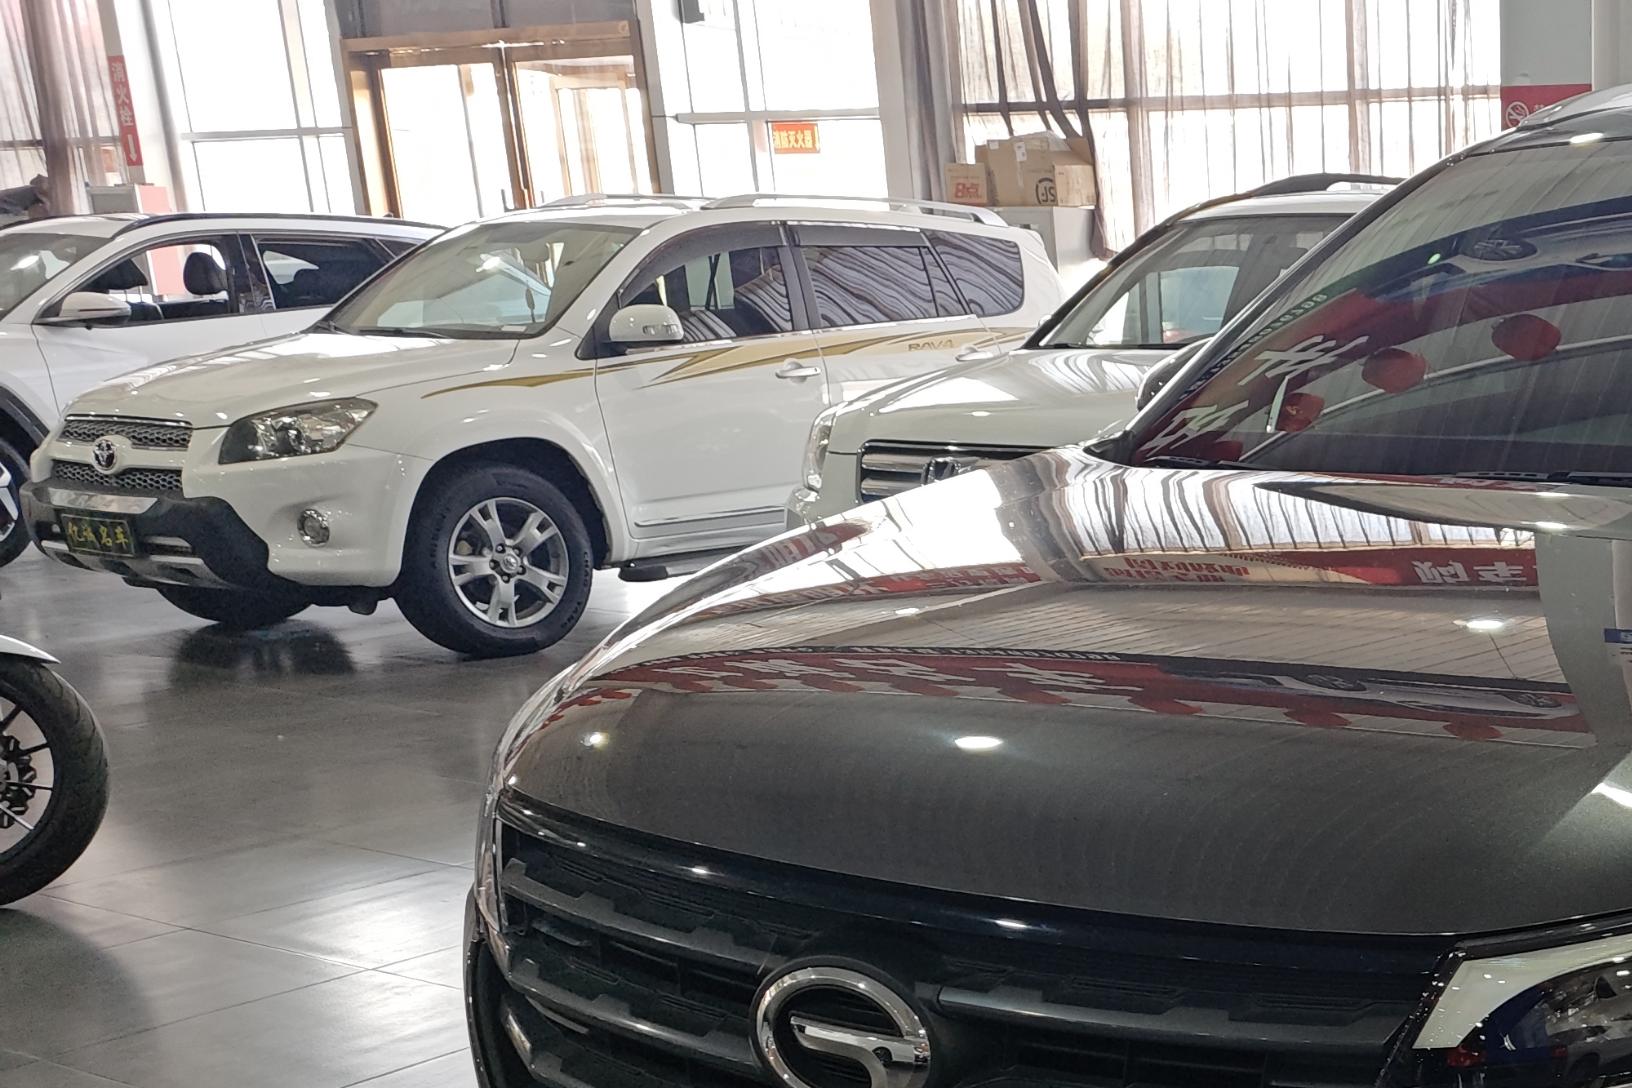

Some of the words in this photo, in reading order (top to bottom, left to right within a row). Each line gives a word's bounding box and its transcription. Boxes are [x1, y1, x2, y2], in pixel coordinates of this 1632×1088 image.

[111, 62, 134, 126] 消火栓
[908, 339, 953, 351] RAV4
